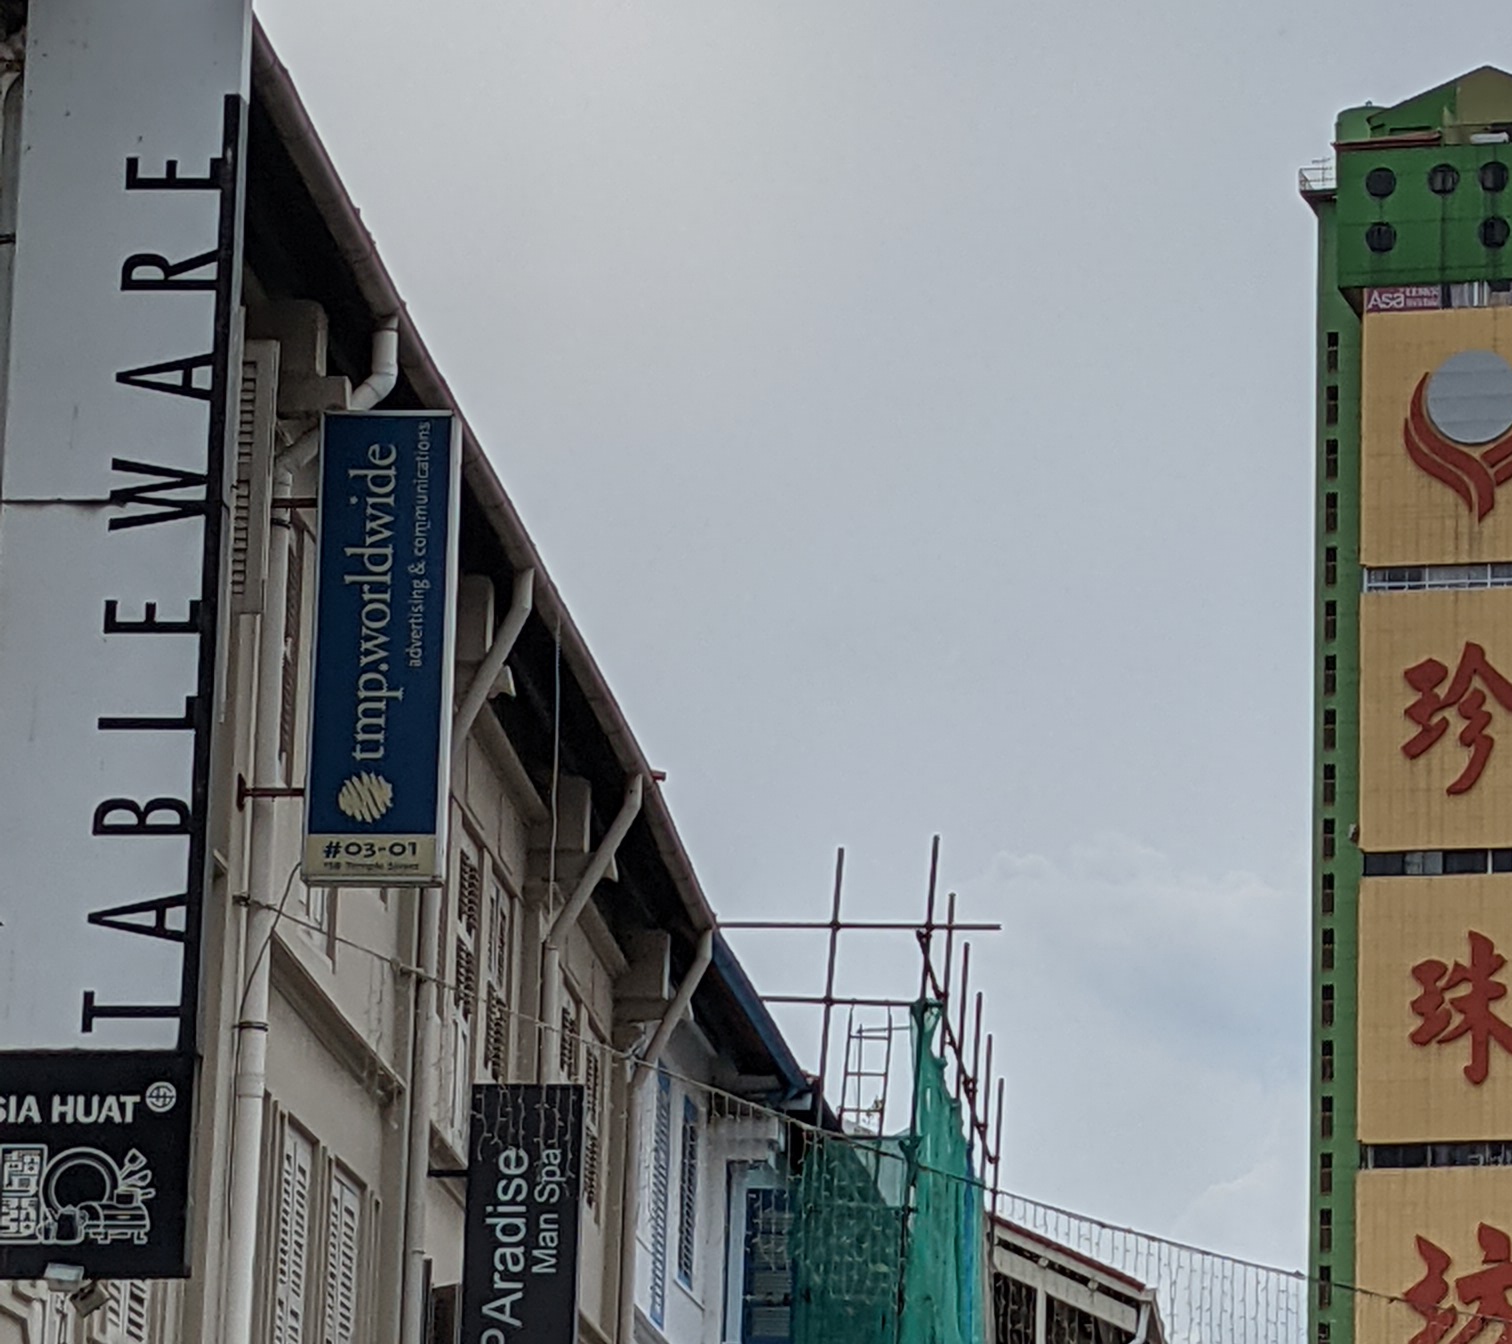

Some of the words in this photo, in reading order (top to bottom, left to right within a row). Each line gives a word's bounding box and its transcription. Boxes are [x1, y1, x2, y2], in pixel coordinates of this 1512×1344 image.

[409, 420, 432, 557] communications
[81, 156, 224, 1033] TABLEWARE
[407, 560, 427, 576] &
[342, 442, 404, 762] tmp.worldwide
[405, 579, 431, 668] advertising
[323, 840, 417, 859] #03-01
[51, 1094, 141, 1124] HUAT
[534, 1148, 564, 1205] Spa
[531, 1213, 560, 1276] Man
